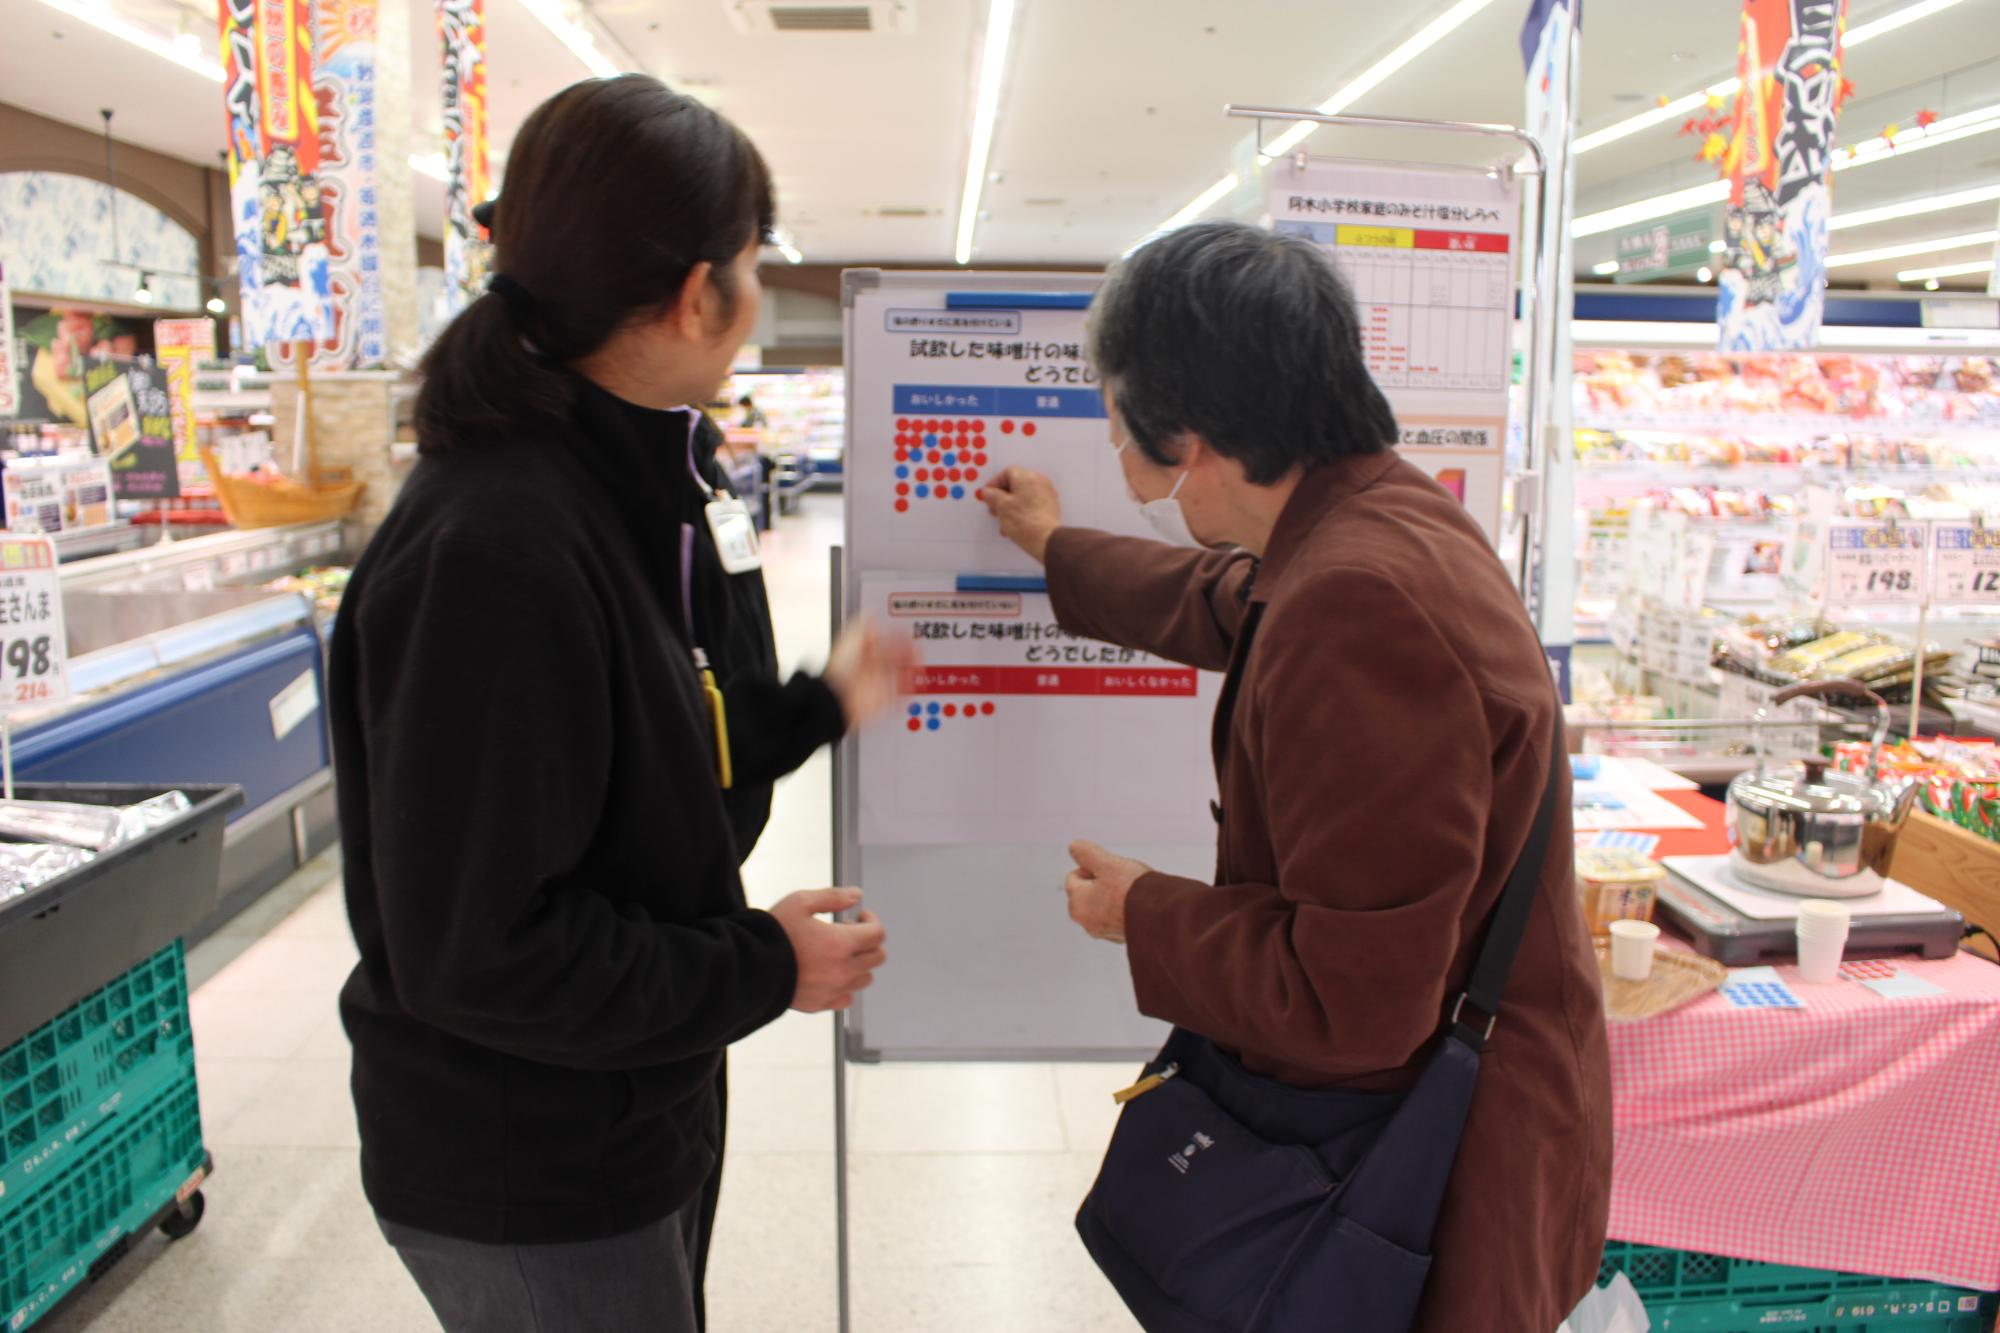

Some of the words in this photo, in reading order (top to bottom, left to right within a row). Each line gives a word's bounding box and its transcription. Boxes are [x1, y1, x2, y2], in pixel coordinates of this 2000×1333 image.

[910, 339, 1085, 360] 試飲した味噌汁の味
[911, 394, 979, 407] おいしかった
[1867, 570, 1912, 590] 198
[1104, 674, 1191, 690] おいしくなかった
